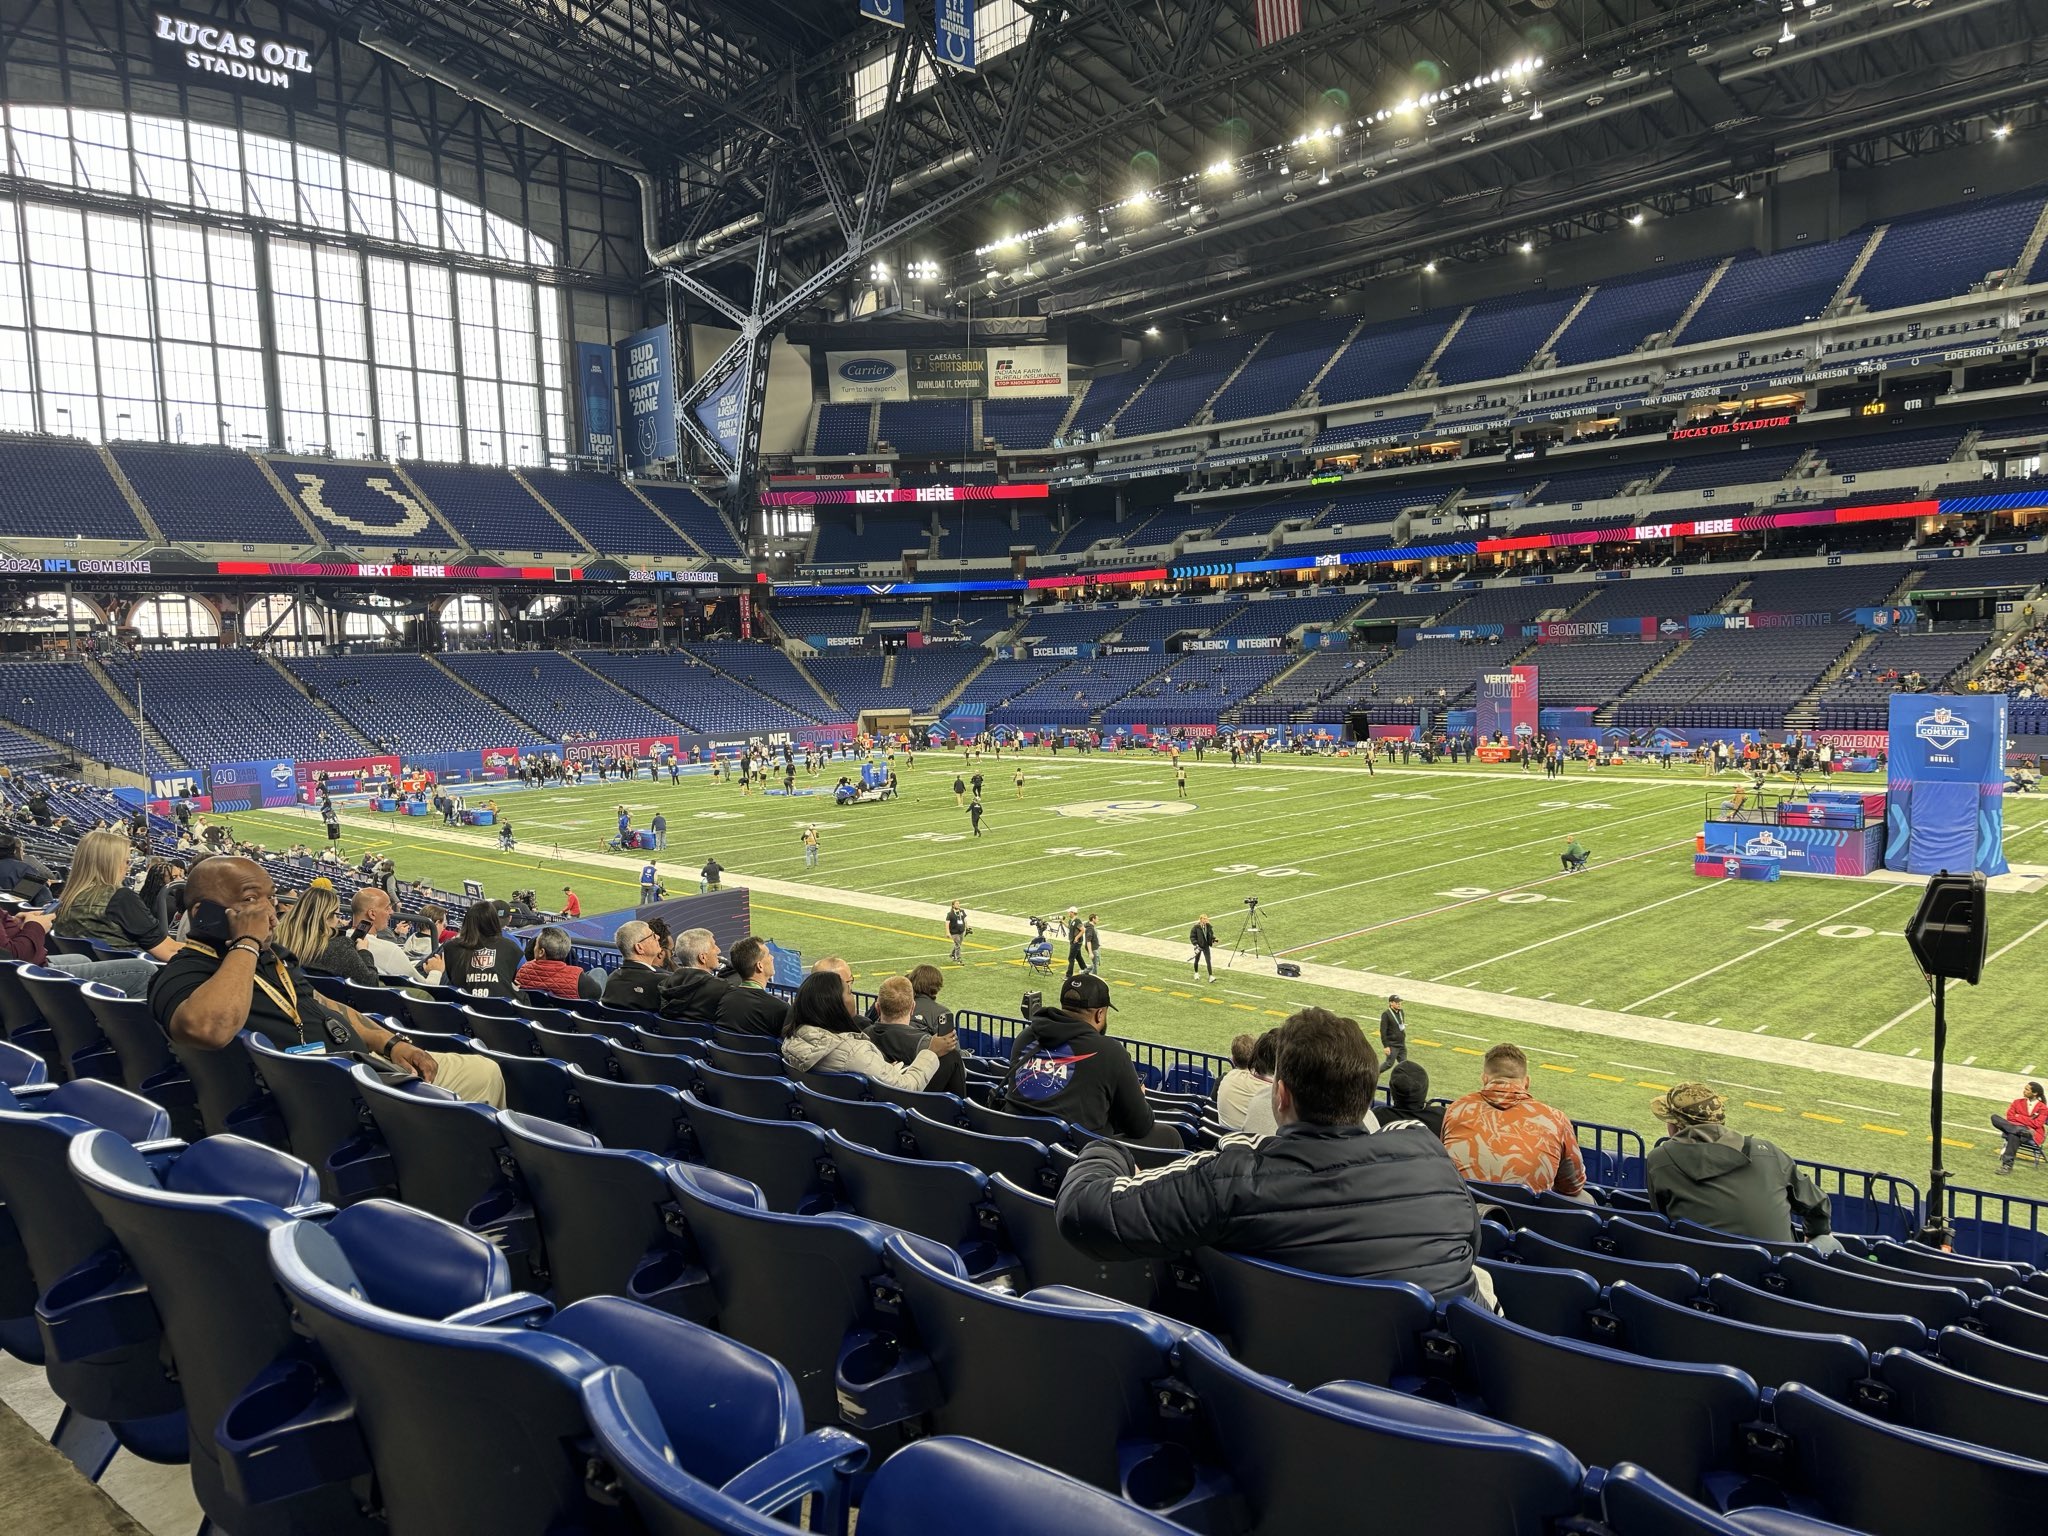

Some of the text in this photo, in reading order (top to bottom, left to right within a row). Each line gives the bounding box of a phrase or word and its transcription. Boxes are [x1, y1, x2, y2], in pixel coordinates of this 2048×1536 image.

[941, 18, 970, 39] CHAMPIONS
[156, 15, 312, 73] LUCAS OIL
[186, 51, 289, 89] STADIUM
[631, 343, 653, 364] BUD
[1944, 341, 2029, 361] EDGERRIN JAMES
[628, 358, 659, 382] LIGHT
[847, 364, 888, 377] Carrier
[929, 360, 984, 372] SPORTSBOOK
[1769, 363, 1887, 387] MARVIN HARRISON 1996-08
[917, 380, 945, 389] DOWNLOAD
[954, 379, 980, 388] EMPEROR!
[629, 380, 660, 403] PARTY
[1641, 388, 1720, 406] TONY DUNGY 2002-08
[633, 397, 658, 416] ZONE
[720, 394, 736, 406] BUD
[1862, 399, 1922, 415] 1:47 QTR
[717, 405, 738, 416] LIGHT
[1550, 406, 1597, 420] COLTS NATION
[718, 418, 738, 430] PARTY
[1435, 427, 1447, 437] JIM
[1448, 423, 1484, 435] HARBAUGH
[1672, 416, 1790, 440] LUCAS OIL STADIUM
[589, 432, 612, 445] BUD
[720, 428, 738, 439] ZONE
[1314, 441, 1355, 453] MARCHIBRODA
[1514, 452, 1535, 460] verizon
[855, 489, 894, 503] NEXT
[916, 487, 955, 501] HERE
[1635, 524, 1672, 539] NEXT
[1694, 519, 1733, 534] HERE
[0, 559, 150, 573] 2024 NFL COMBINE
[358, 565, 393, 577] NEXT
[412, 565, 445, 577] HERE
[629, 570, 718, 582] 2024 NFL COMBINE
[1085, 575, 1099, 584] NFL
[1725, 613, 1831, 629] NFL COMBINE
[1459, 630, 1475, 639] NFL+
[1521, 622, 1608, 637] NFL COMBINE
[827, 636, 864, 646] RESPECT
[1237, 638, 1282, 648] INTEGRITY
[1033, 647, 1078, 656] EXCELLENCE
[1483, 674, 1526, 683] VERTICAL
[1484, 684, 1526, 698] JUMP
[1153, 727, 1169, 735] NFL
[1921, 728, 1965, 736] COMBINE
[769, 732, 794, 746] NFL
[214, 769, 236, 784] 40
[1212, 864, 1302, 878] 30
[1434, 887, 1547, 904] 20
[1747, 918, 1875, 940] 10
[473, 955, 494, 967] NFL
[466, 973, 499, 983] MEDIA
[472, 988, 489, 997] 880
